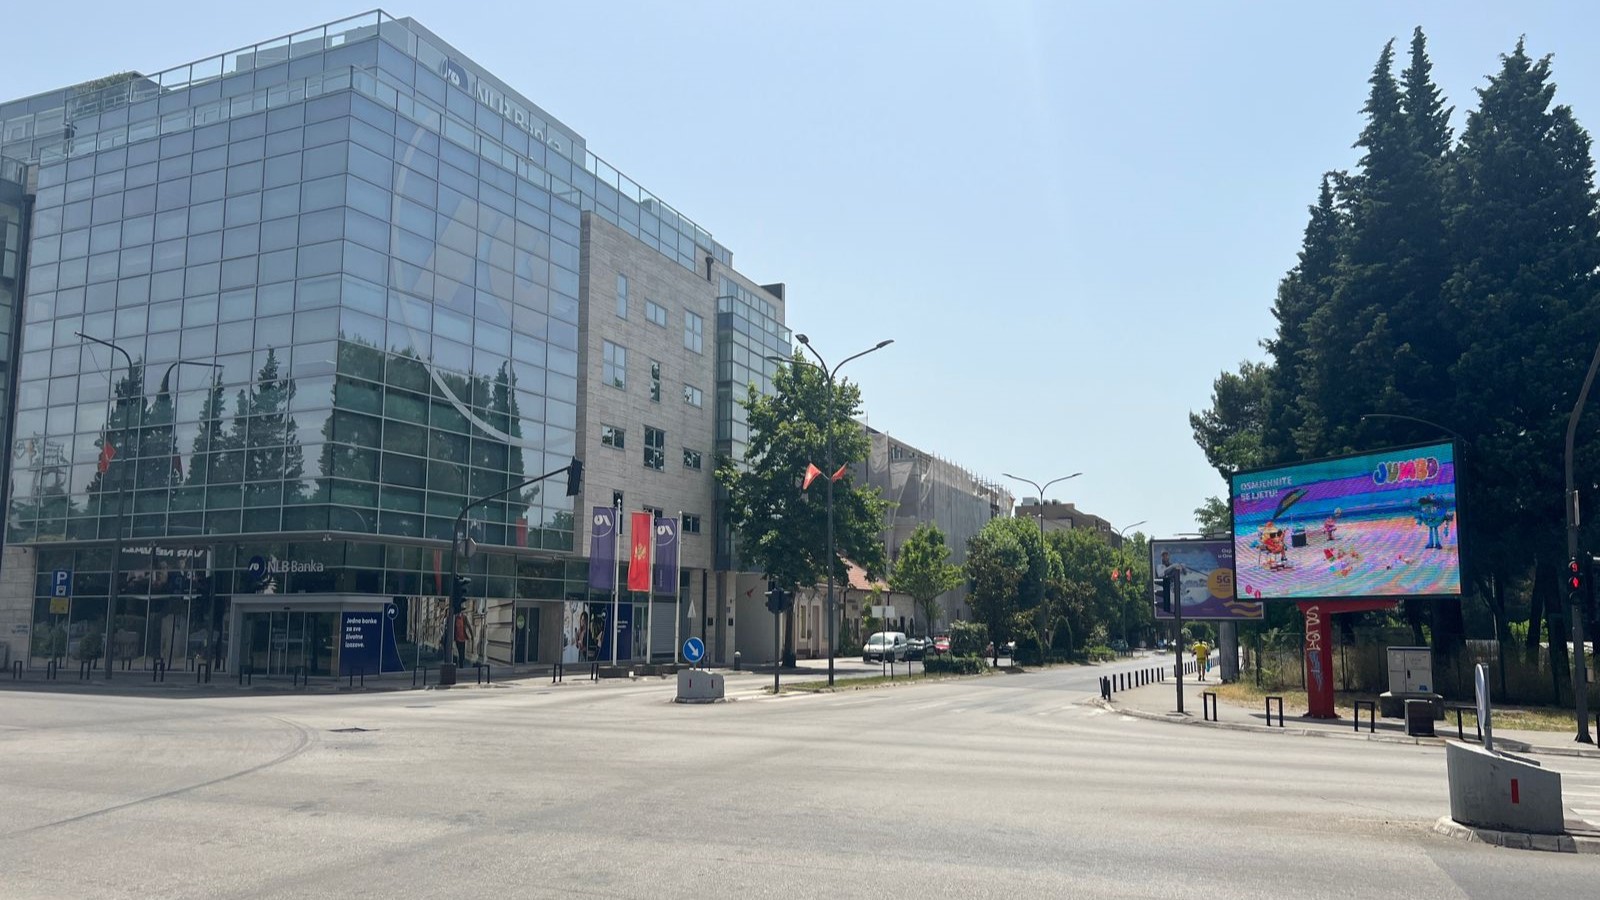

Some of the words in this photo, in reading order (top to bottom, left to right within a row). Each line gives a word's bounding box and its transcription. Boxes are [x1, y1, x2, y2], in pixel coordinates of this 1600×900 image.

[1373, 457, 1439, 485] JUMBO
[267, 560, 289, 573] NLB
[291, 559, 324, 573] Banka
[56, 571, 68, 585] P
[1216, 575, 1231, 584] 5G
